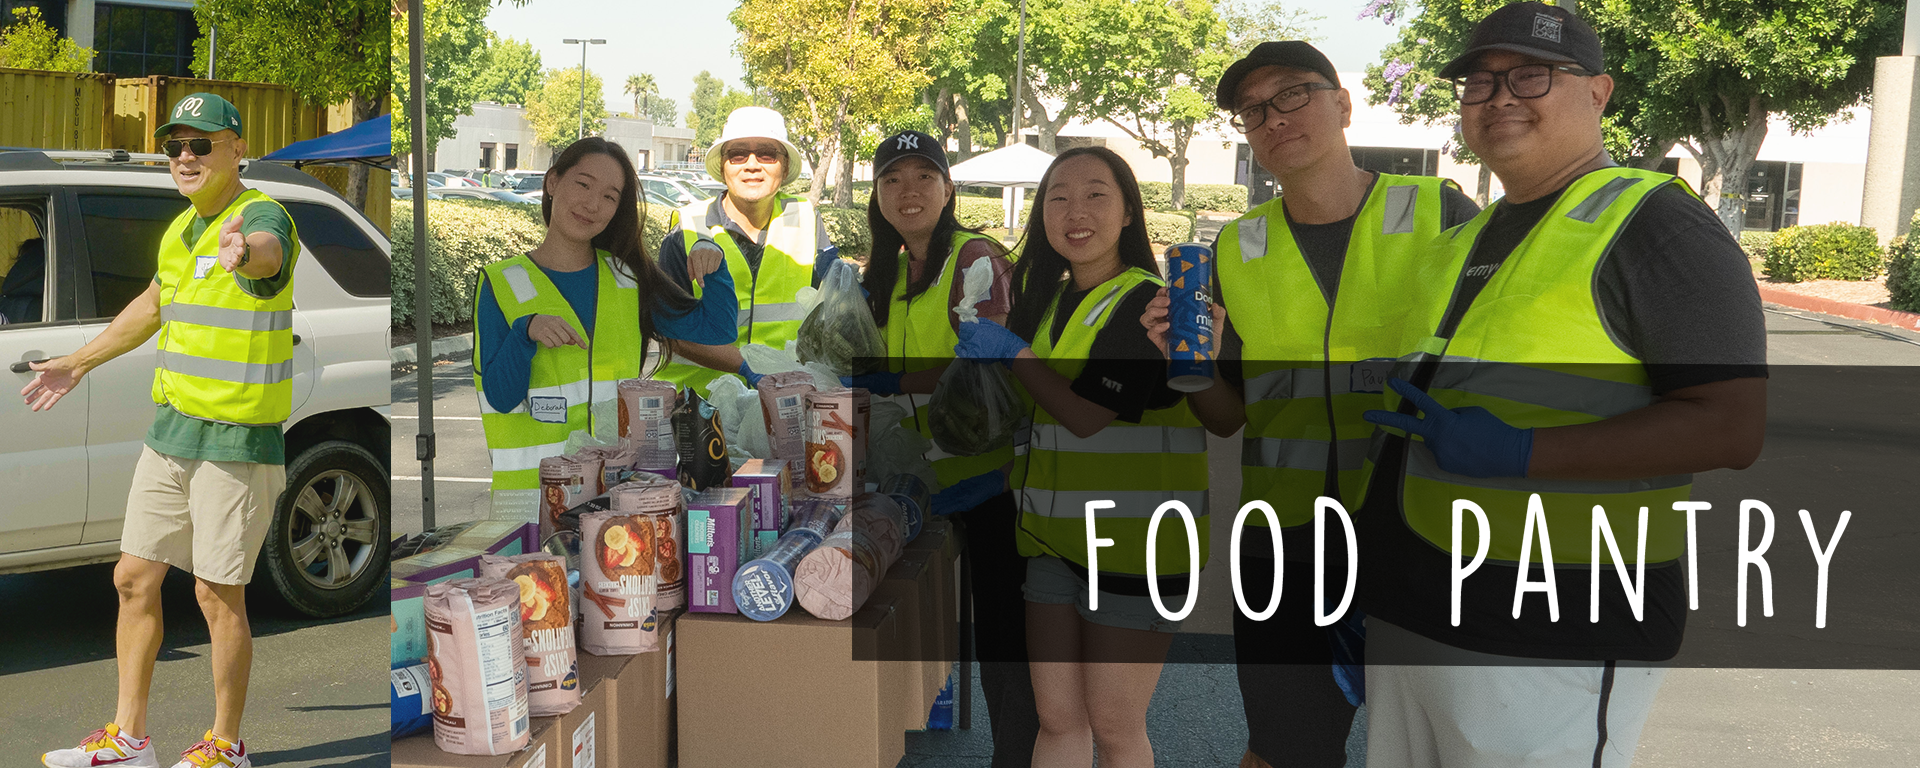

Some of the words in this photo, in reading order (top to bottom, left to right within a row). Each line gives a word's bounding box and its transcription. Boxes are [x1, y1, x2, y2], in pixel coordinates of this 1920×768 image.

[896, 133, 919, 150] NY
[534, 401, 565, 411] Deborah
[744, 580, 766, 612] ANOTHER
[750, 574, 777, 612] LEVEL
[544, 650, 571, 678] CRISP
